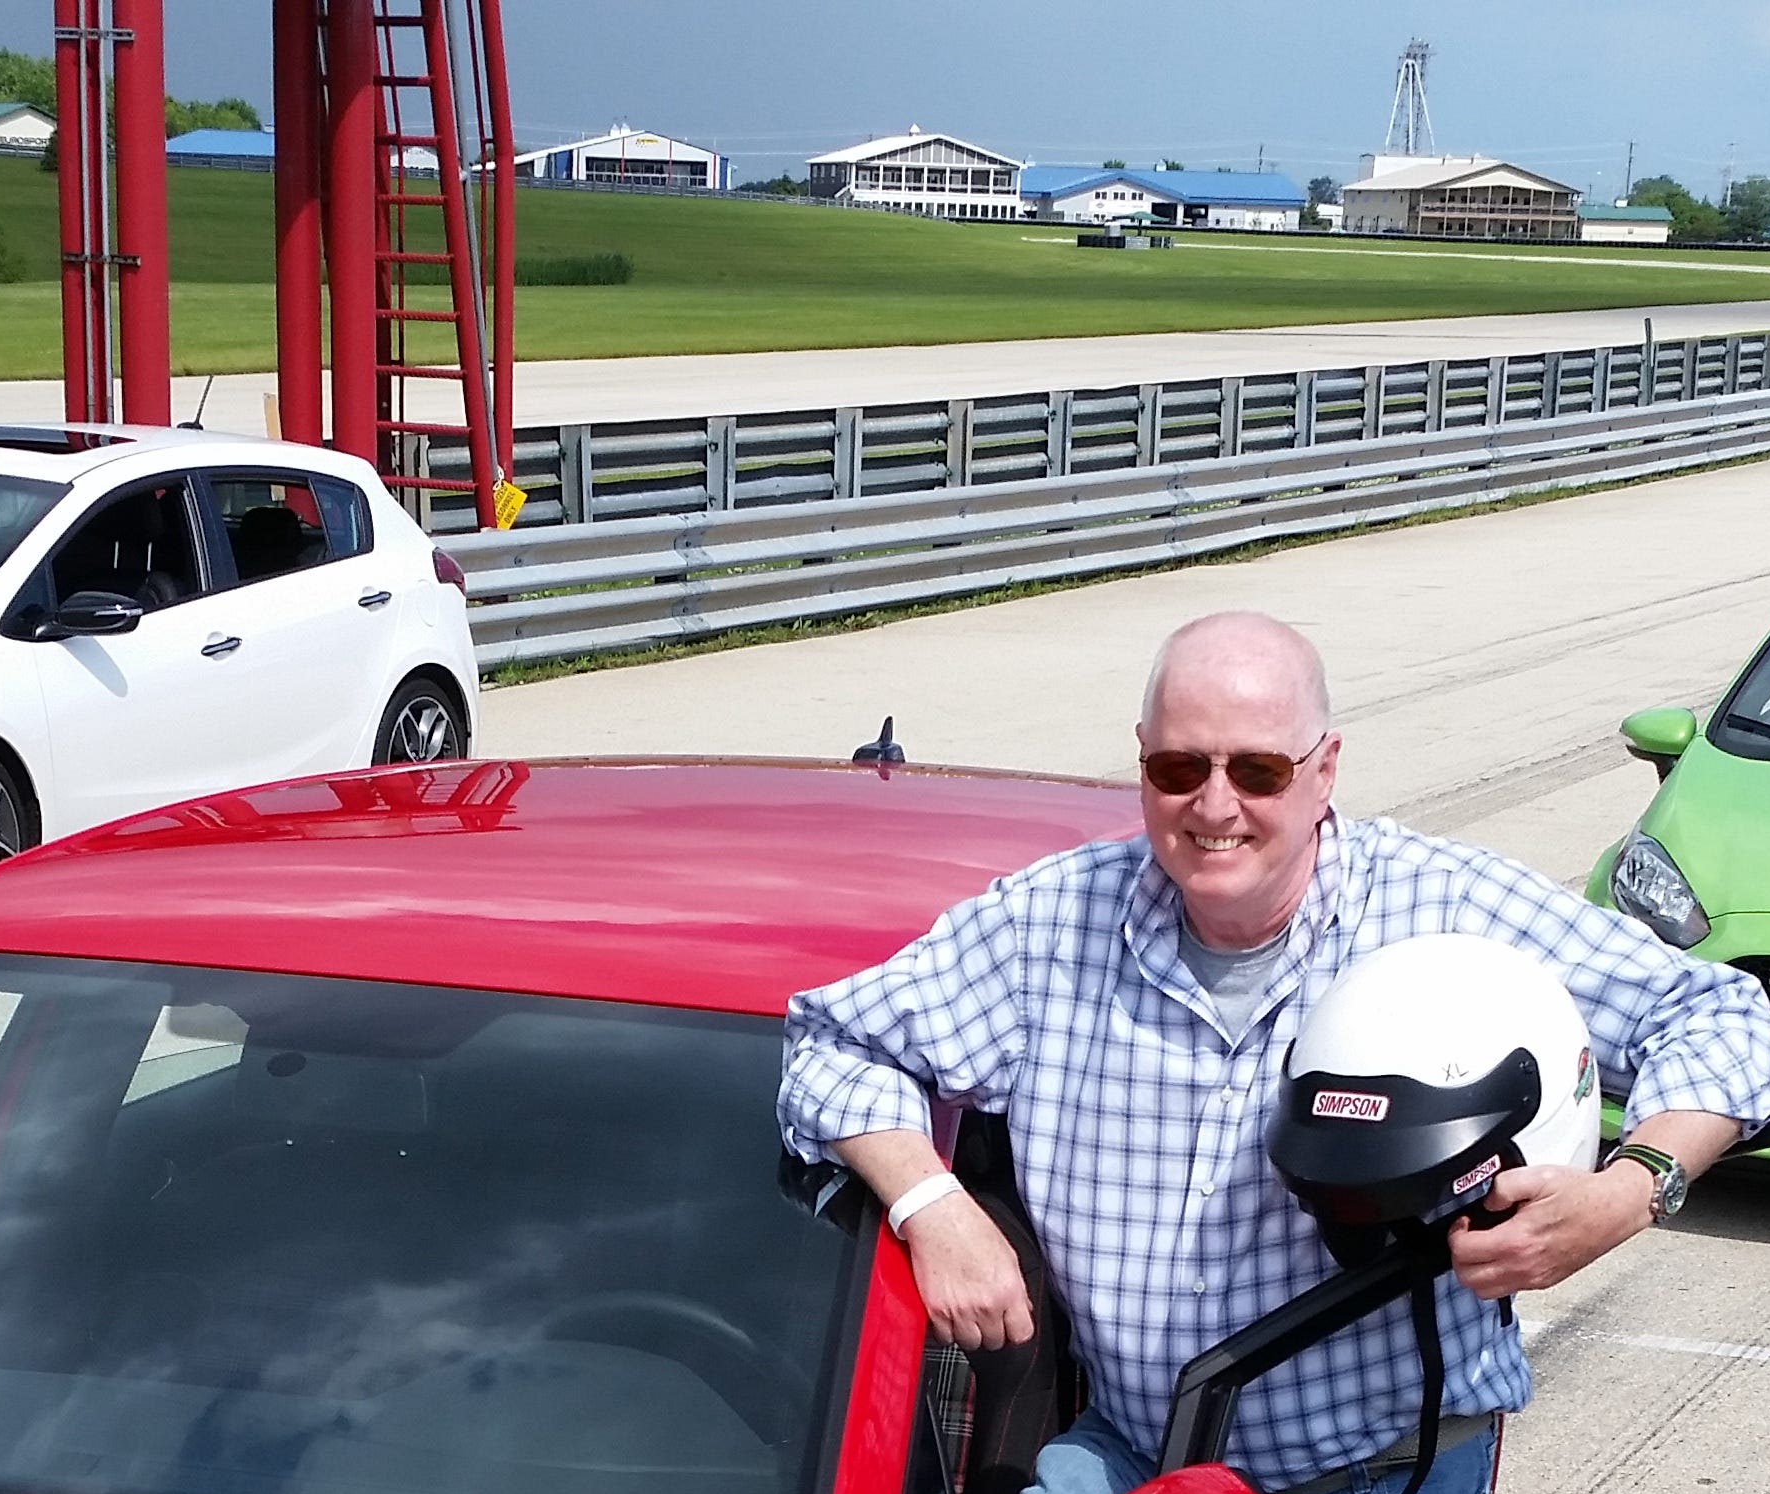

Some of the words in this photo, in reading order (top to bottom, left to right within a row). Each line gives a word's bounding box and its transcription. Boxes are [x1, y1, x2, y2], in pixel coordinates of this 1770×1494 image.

[1441, 1063, 1469, 1082] XL
[1316, 1094, 1383, 1117] SIMPSON
[1455, 1158, 1497, 1192] SIMPSON
